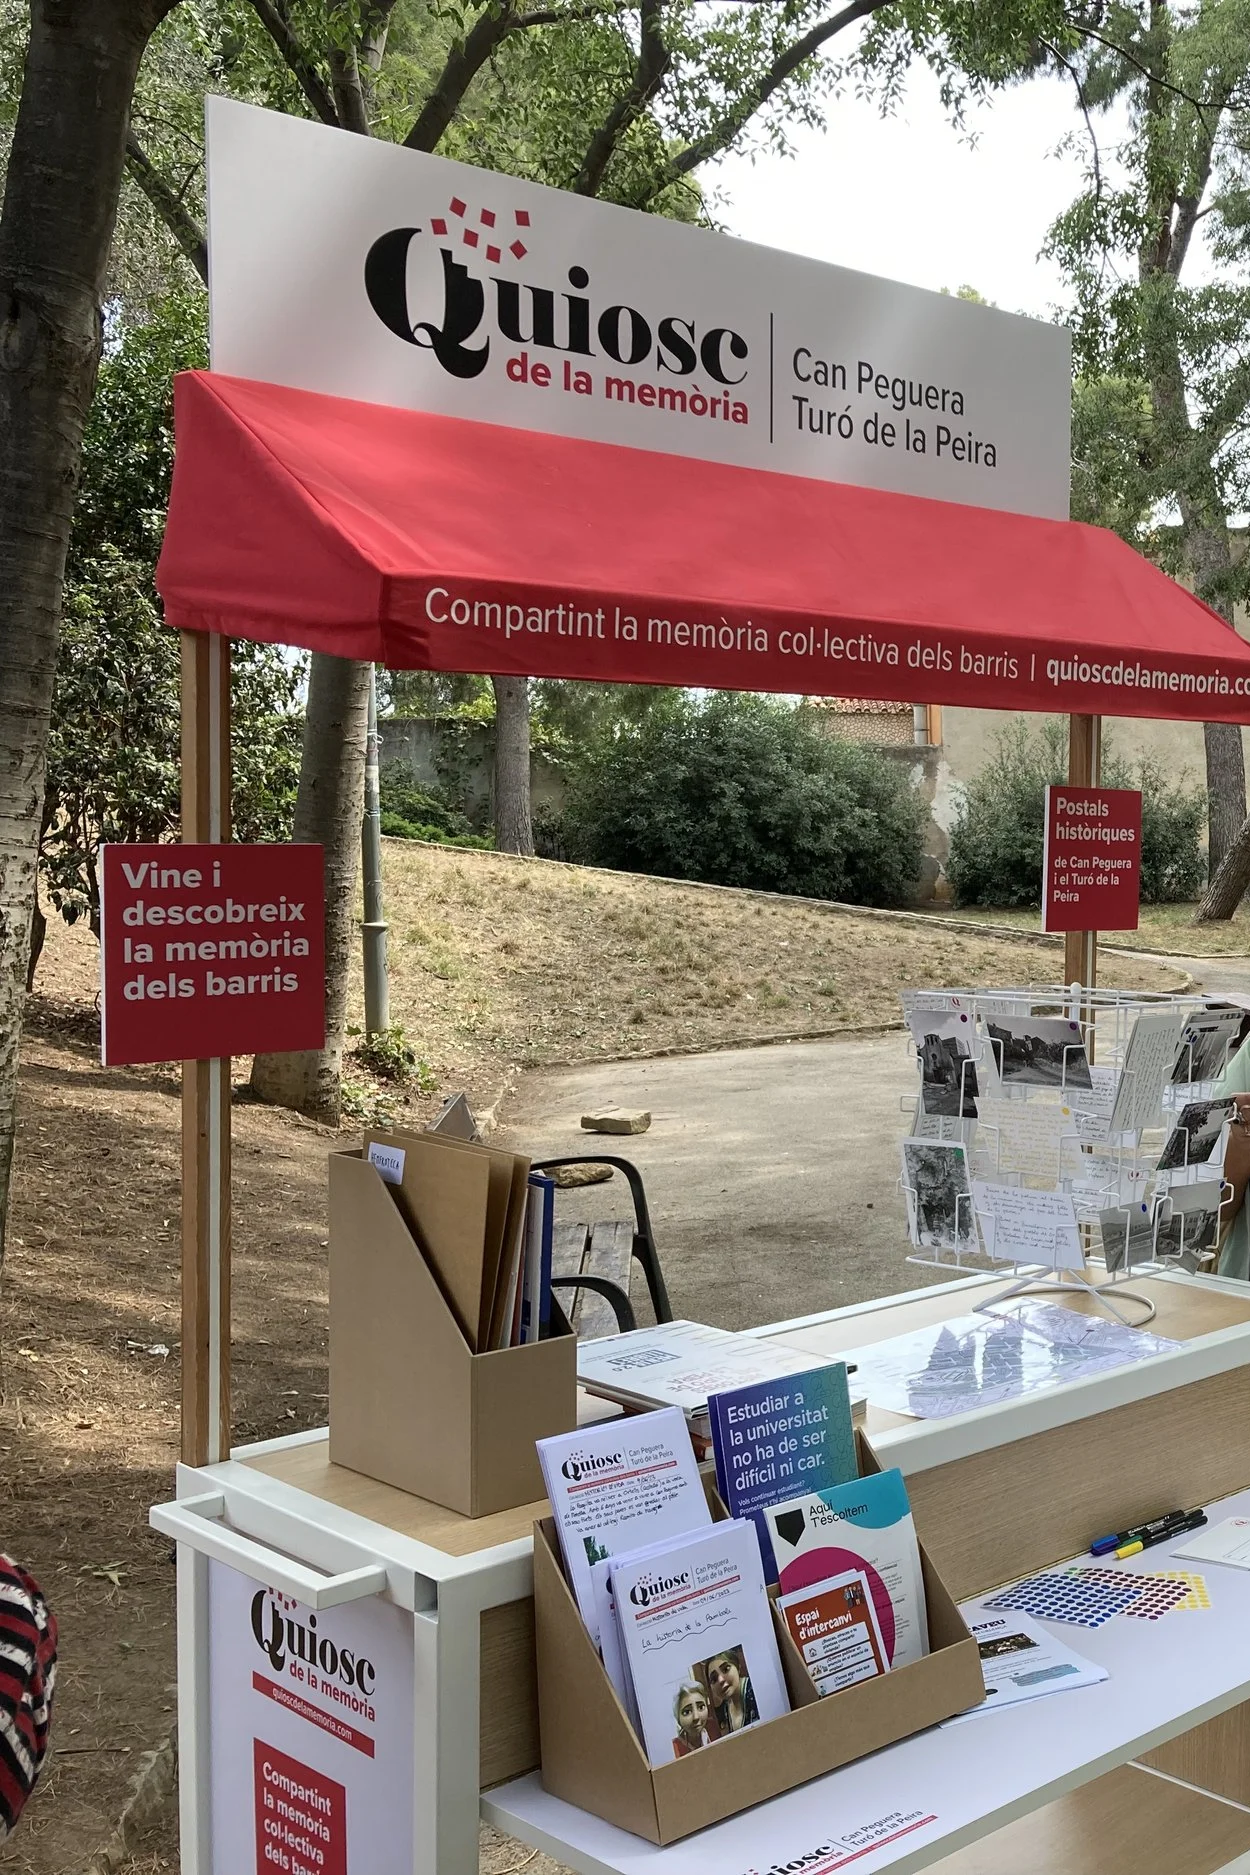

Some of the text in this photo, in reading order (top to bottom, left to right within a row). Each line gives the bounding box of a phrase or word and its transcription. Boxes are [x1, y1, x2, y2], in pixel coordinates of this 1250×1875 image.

[364, 227, 748, 385] Quiosc
[507, 352, 748, 425] de la memòria
[793, 348, 965, 415] Can Peguera
[793, 396, 997, 467] Turó de la Peira
[425, 587, 606, 639] Compartint
[615, 607, 638, 641] la
[647, 616, 769, 653] memòria
[778, 619, 900, 666] col·lectiva
[907, 640, 953, 672] dels
[960, 644, 1018, 680] barris
[1056, 797, 1109, 817] Postals
[1055, 821, 1135, 845] històriques
[121, 860, 221, 888] Vine i
[1054, 856, 1132, 871] de Can Peguera
[1054, 873, 1119, 885] i el Turó de la
[122, 896, 305, 926] descobreix
[1053, 890, 1080, 902] Peira
[124, 931, 309, 963] la memòria
[123, 966, 299, 1000] dels barris
[727, 1392, 804, 1424] Estudiar a
[730, 1406, 829, 1446] la universitat
[628, 1443, 664, 1457] Can Peguera
[631, 1457, 644, 1466] Turó
[660, 1450, 673, 1459] Peira
[732, 1428, 826, 1468] no ha de ser
[561, 1452, 621, 1481] Quiosc
[584, 1471, 592, 1479] de
[600, 1464, 625, 1475] memòria
[735, 1453, 825, 1491] difícil ni car.
[738, 1480, 805, 1506] Vols continuar estudiant?
[809, 1499, 833, 1517] Aquí
[811, 1503, 868, 1528] T'escoltem
[695, 1558, 729, 1575] Can Peguera
[696, 1576, 709, 1584] Turó
[710, 1572, 717, 1580] de
[724, 1564, 737, 1574] Peira
[630, 1572, 688, 1606] Quiosc
[667, 1584, 691, 1596] memòria
[795, 1607, 820, 1626] Espai
[799, 1610, 852, 1640] d'intercanvi
[251, 1589, 376, 1696] Quiosc
[290, 1659, 376, 1722] de la memòria
[272, 1686, 352, 1741] quioscdelamemoria.com
[263, 1761, 332, 1816] Compartint
[263, 1787, 330, 1843] la memòria
[841, 1830, 863, 1842] Can
[860, 1811, 902, 1832] Peguera
[850, 1810, 923, 1846] Turó de la Peira
[264, 1817, 324, 1866] col·lectiva
[264, 1842, 289, 1870] dels
